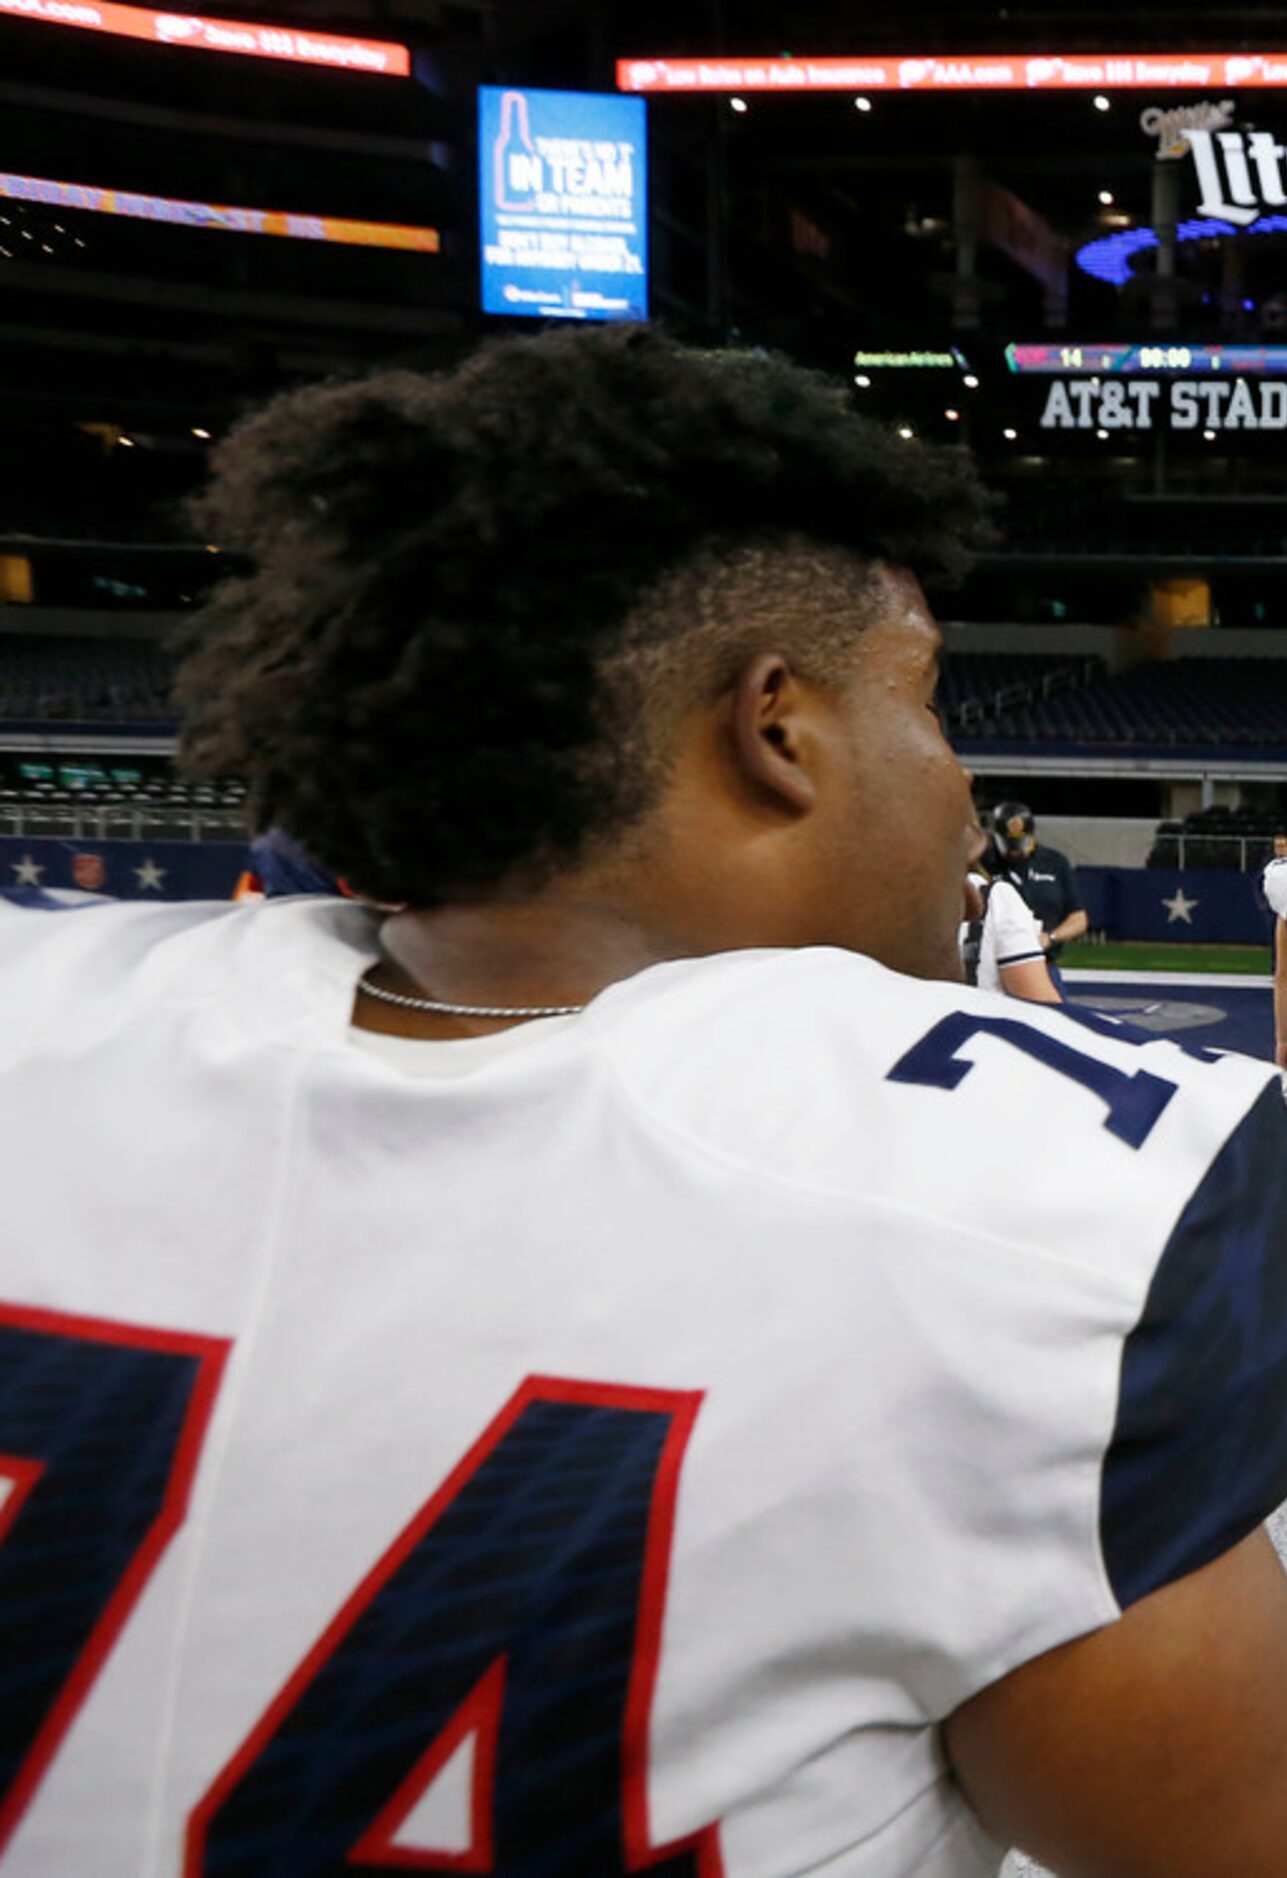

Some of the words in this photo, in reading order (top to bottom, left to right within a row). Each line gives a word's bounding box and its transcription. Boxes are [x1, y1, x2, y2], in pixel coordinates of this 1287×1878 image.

[509, 153, 543, 192] IN
[546, 157, 633, 197] TEAM
[1060, 347, 1083, 369] 14
[1040, 380, 1160, 429] AT&T
